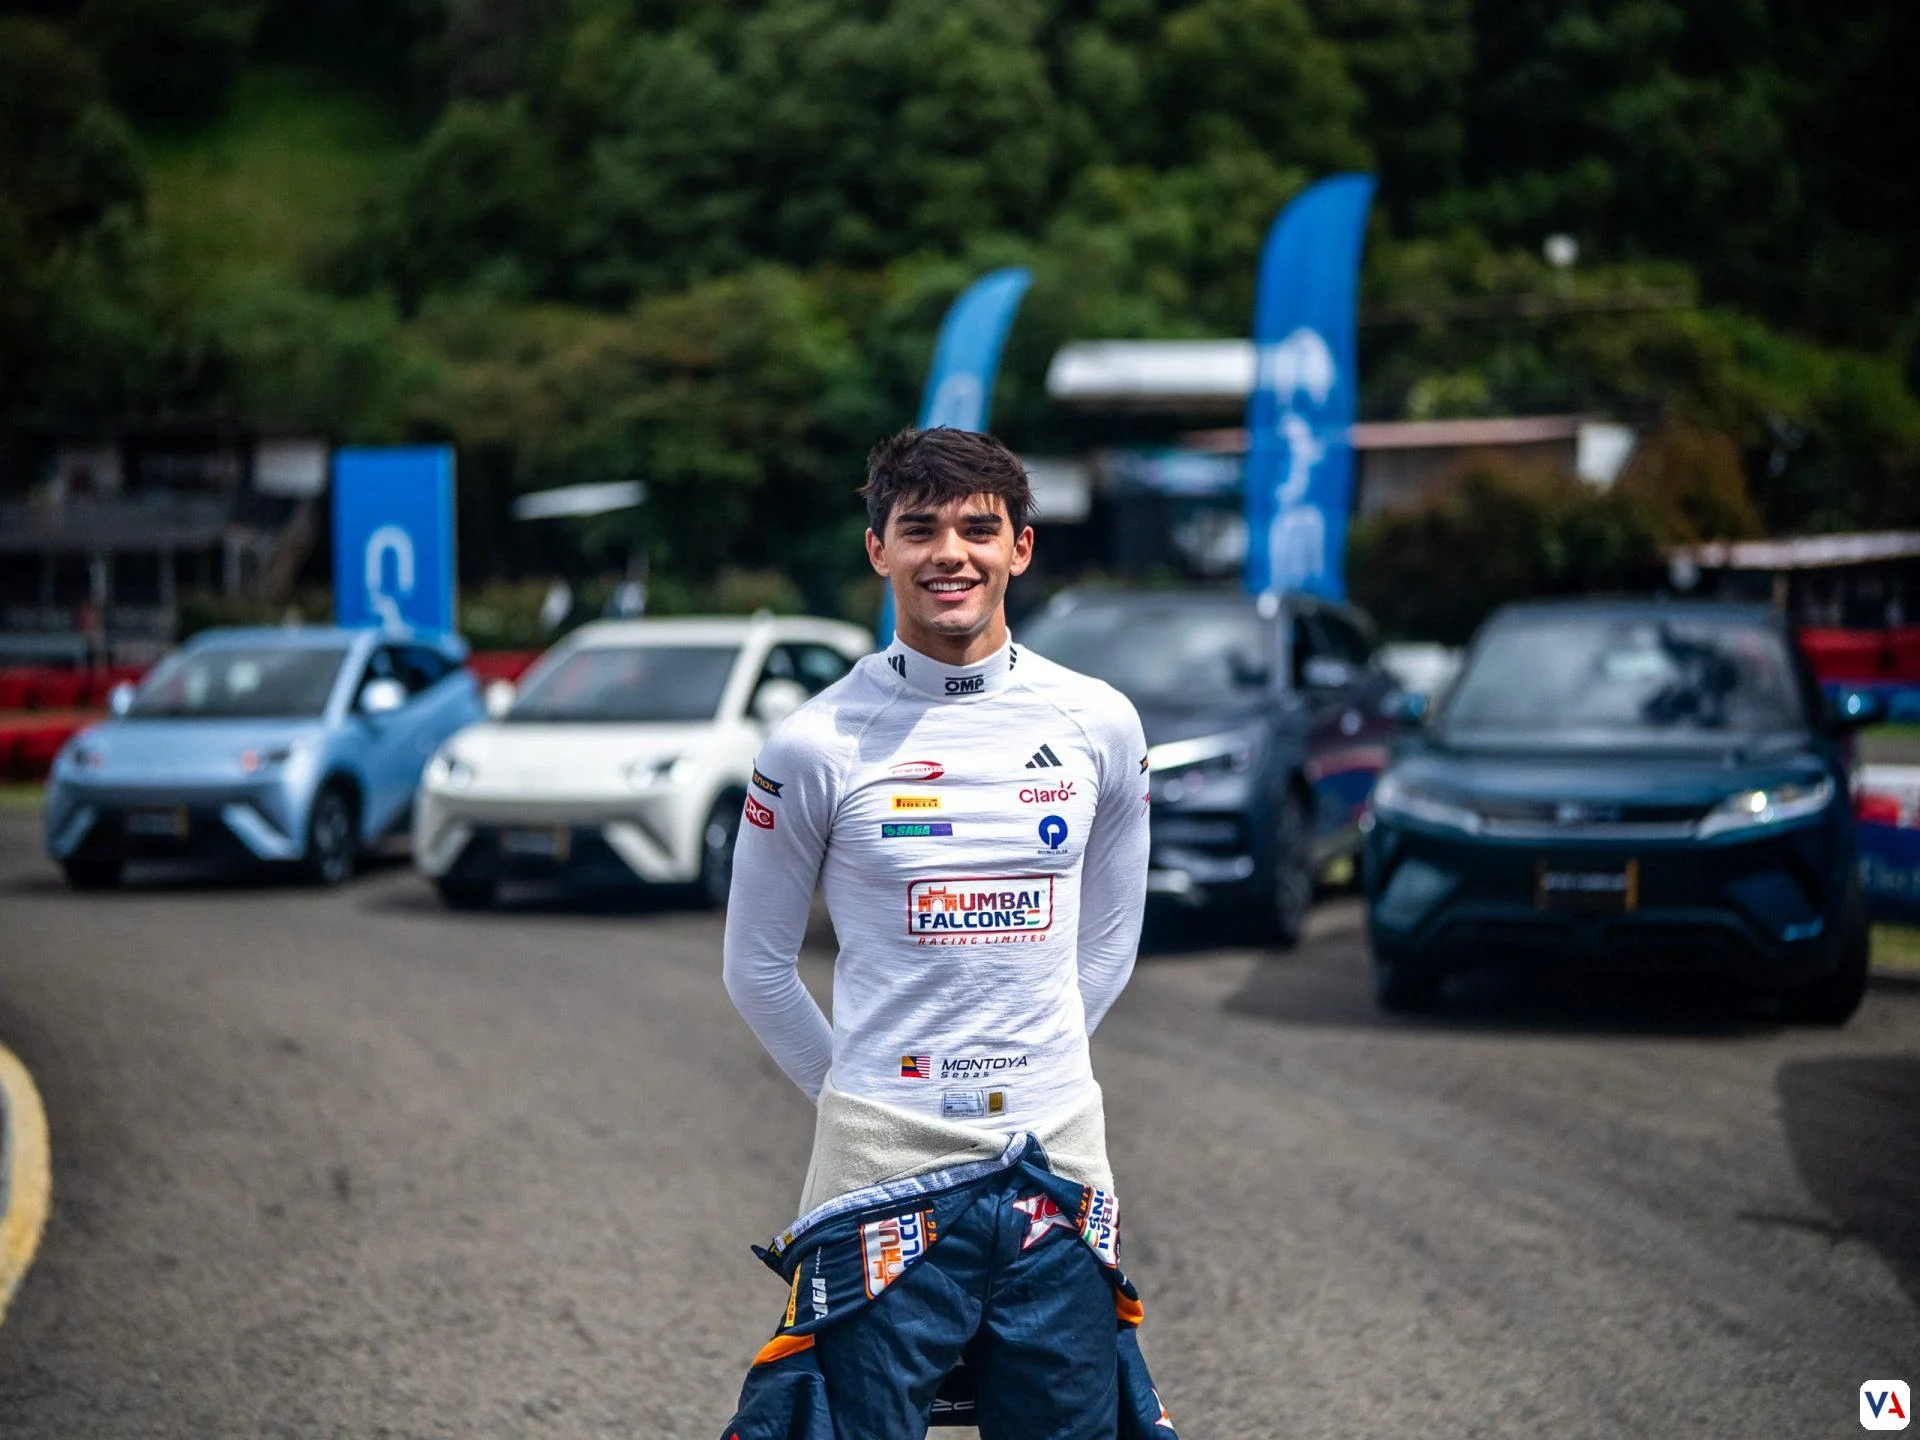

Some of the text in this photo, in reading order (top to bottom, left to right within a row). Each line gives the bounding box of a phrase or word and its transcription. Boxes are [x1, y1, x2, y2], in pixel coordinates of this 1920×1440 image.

[945, 677, 984, 692] OMP
[1019, 785, 1072, 803] Claro
[896, 825, 930, 836] SAGA
[919, 910, 1026, 929] FALCONS
[919, 934, 1046, 945] RACING LIMITED
[942, 1055, 1028, 1071] MONTOYA
[941, 1071, 990, 1079] Sebas
